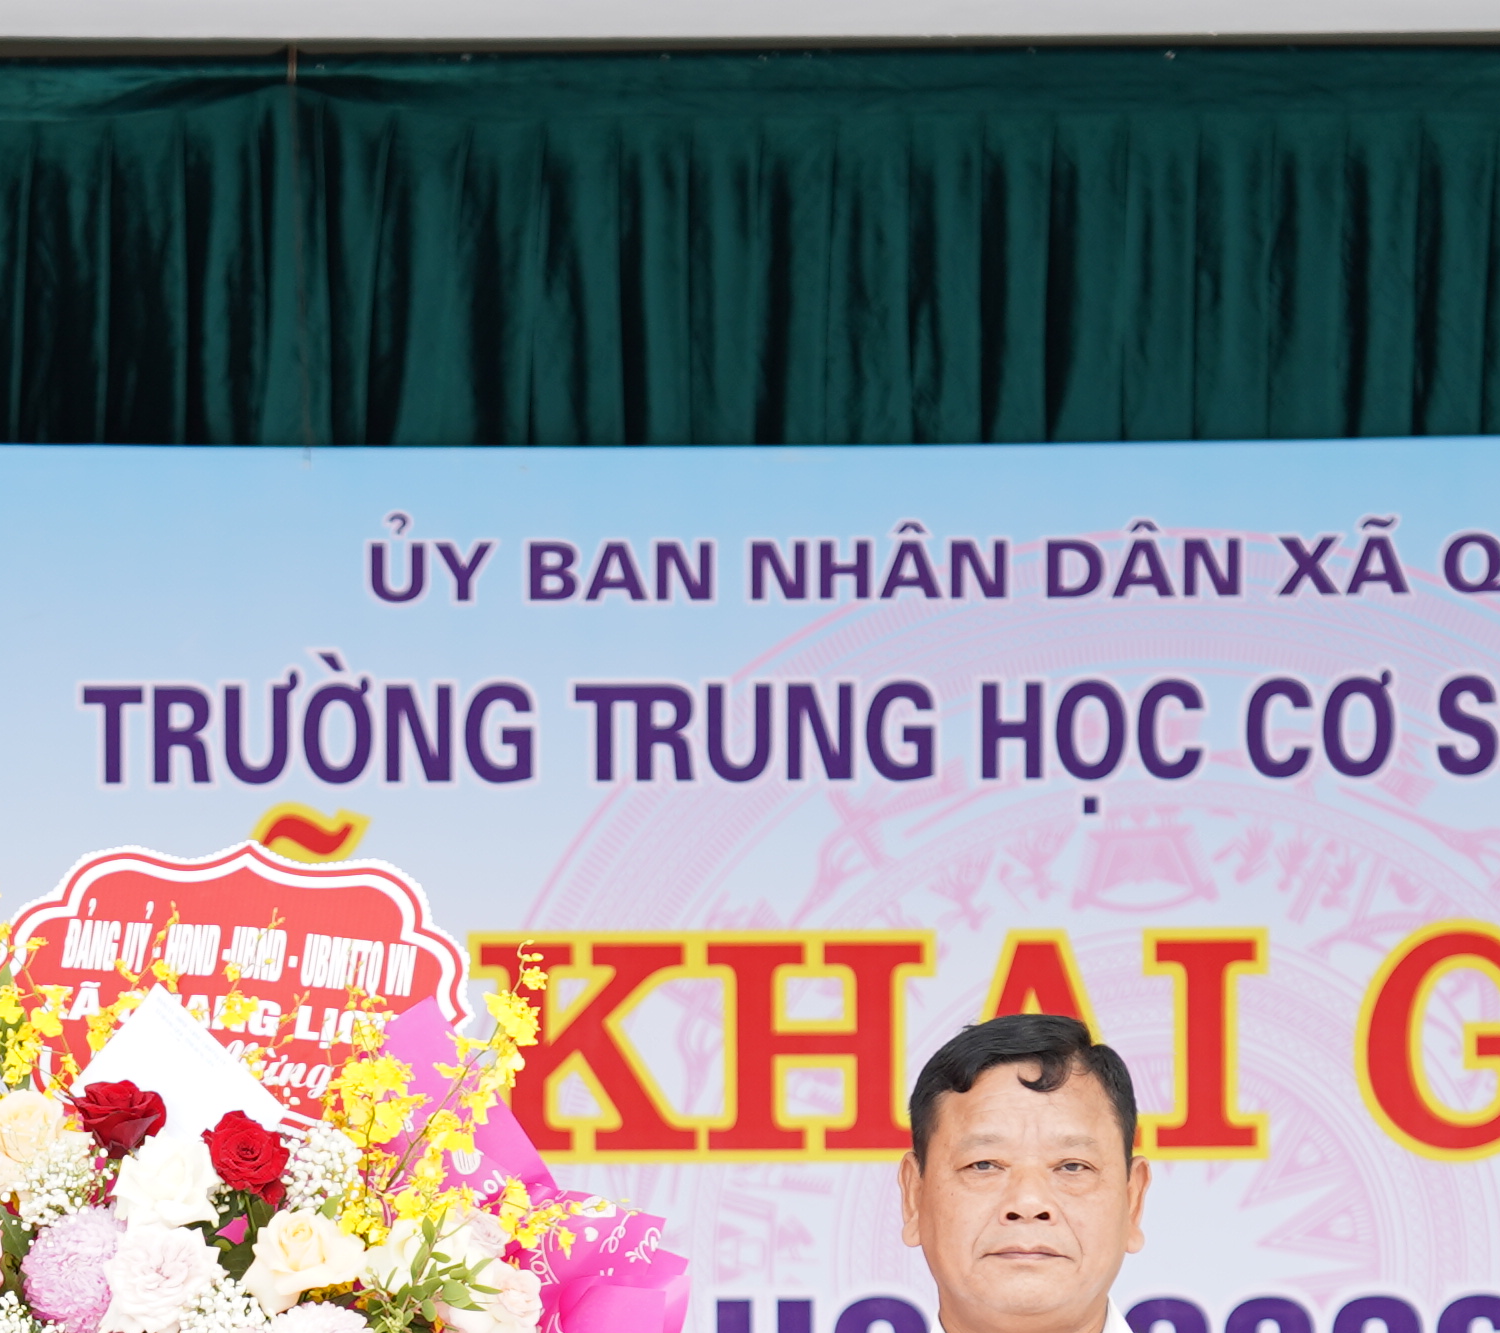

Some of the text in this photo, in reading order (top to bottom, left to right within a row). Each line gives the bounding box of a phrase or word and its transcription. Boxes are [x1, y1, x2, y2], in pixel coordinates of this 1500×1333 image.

[370, 512, 490, 603] ỦY
[528, 541, 712, 601] BAN
[750, 522, 1007, 601] NHÂN
[1046, 520, 1240, 599] DÂN
[1280, 516, 1408, 596] XÃ
[82, 650, 533, 786] TRƯỜNG
[574, 681, 934, 784] TRUNG
[981, 679, 1202, 815] HỌC
[1245, 671, 1394, 779] CƠ
[61, 897, 121, 972] ĐẢNG
[384, 943, 418, 997] VN
